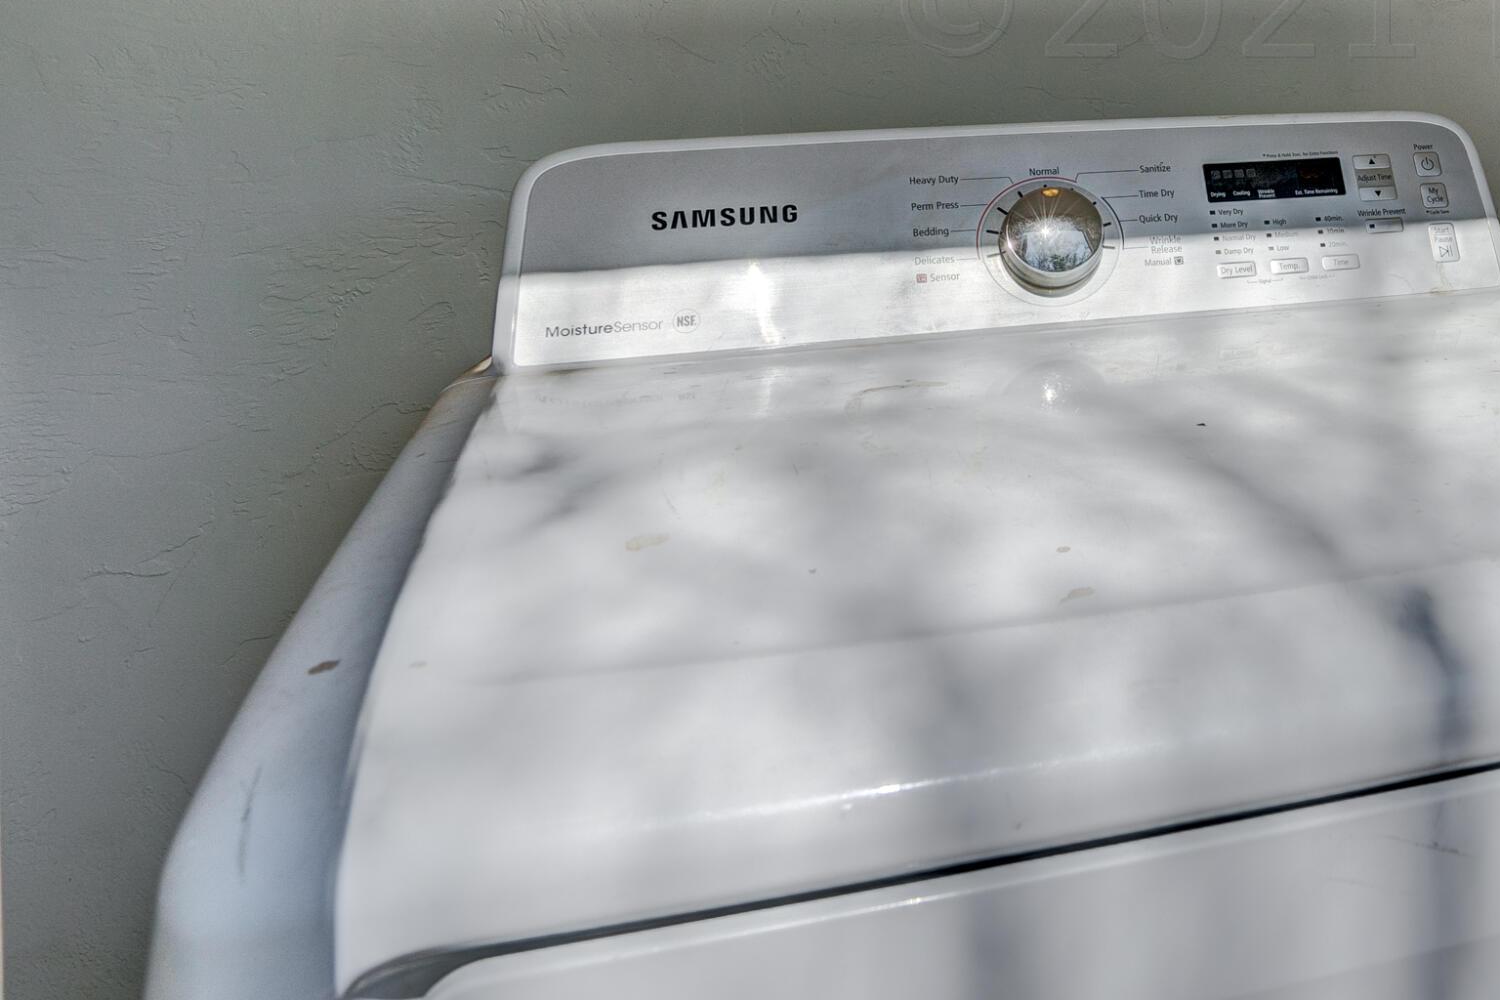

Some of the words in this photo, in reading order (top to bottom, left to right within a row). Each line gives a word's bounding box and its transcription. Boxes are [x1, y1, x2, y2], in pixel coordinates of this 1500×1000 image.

[1029, 167, 1060, 176] Normal
[1140, 164, 1171, 174] Sanitize
[909, 176, 936, 186] Heavy
[938, 175, 959, 185] Duty
[1357, 173, 1376, 182] Adjust
[1377, 172, 1392, 181] Time
[1138, 190, 1158, 198] Time
[1160, 189, 1175, 199] Dry
[1426, 194, 1444, 204] Cycle
[911, 202, 934, 210] Perm
[1218, 210, 1232, 218] Very
[1233, 208, 1244, 218] Dry
[1357, 208, 1380, 217] Wrinkle
[1381, 207, 1406, 216] Prevent
[651, 204, 798, 231] SAMSUNG
[1138, 214, 1162, 224] Quick
[1164, 214, 1178, 224] Dry
[1272, 218, 1287, 227] High
[912, 228, 950, 238] Bedding
[1246, 232, 1256, 242] Dry
[1150, 235, 1182, 245] Wrinkle
[1151, 244, 1182, 254] Release
[1224, 248, 1242, 256] Damp
[1243, 246, 1254, 256] Dry
[914, 255, 955, 266] Delicates
[1144, 256, 1172, 267] Manual
[1220, 266, 1234, 276] Dry
[1234, 264, 1253, 274] Level
[930, 272, 961, 282] Sensor
[545, 320, 664, 338] MoistureSensor
